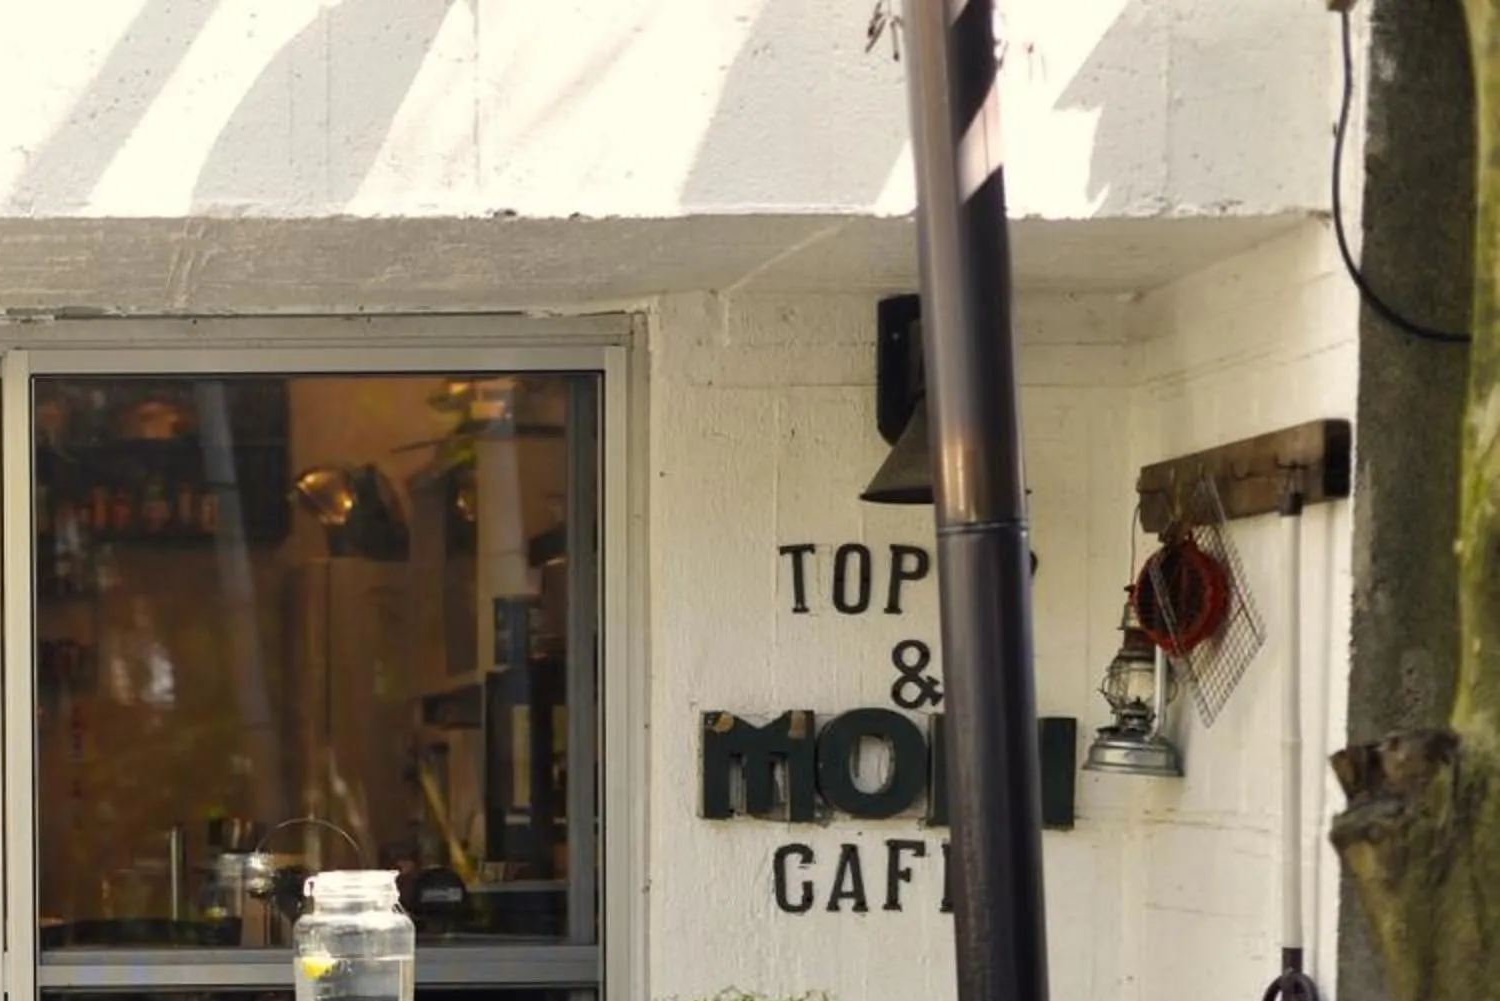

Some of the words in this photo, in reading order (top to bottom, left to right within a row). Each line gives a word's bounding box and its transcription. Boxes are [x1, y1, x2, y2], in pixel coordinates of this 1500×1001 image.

[890, 639, 944, 709] &
[700, 707, 1077, 829] MOI
[773, 839, 955, 913] CAF
